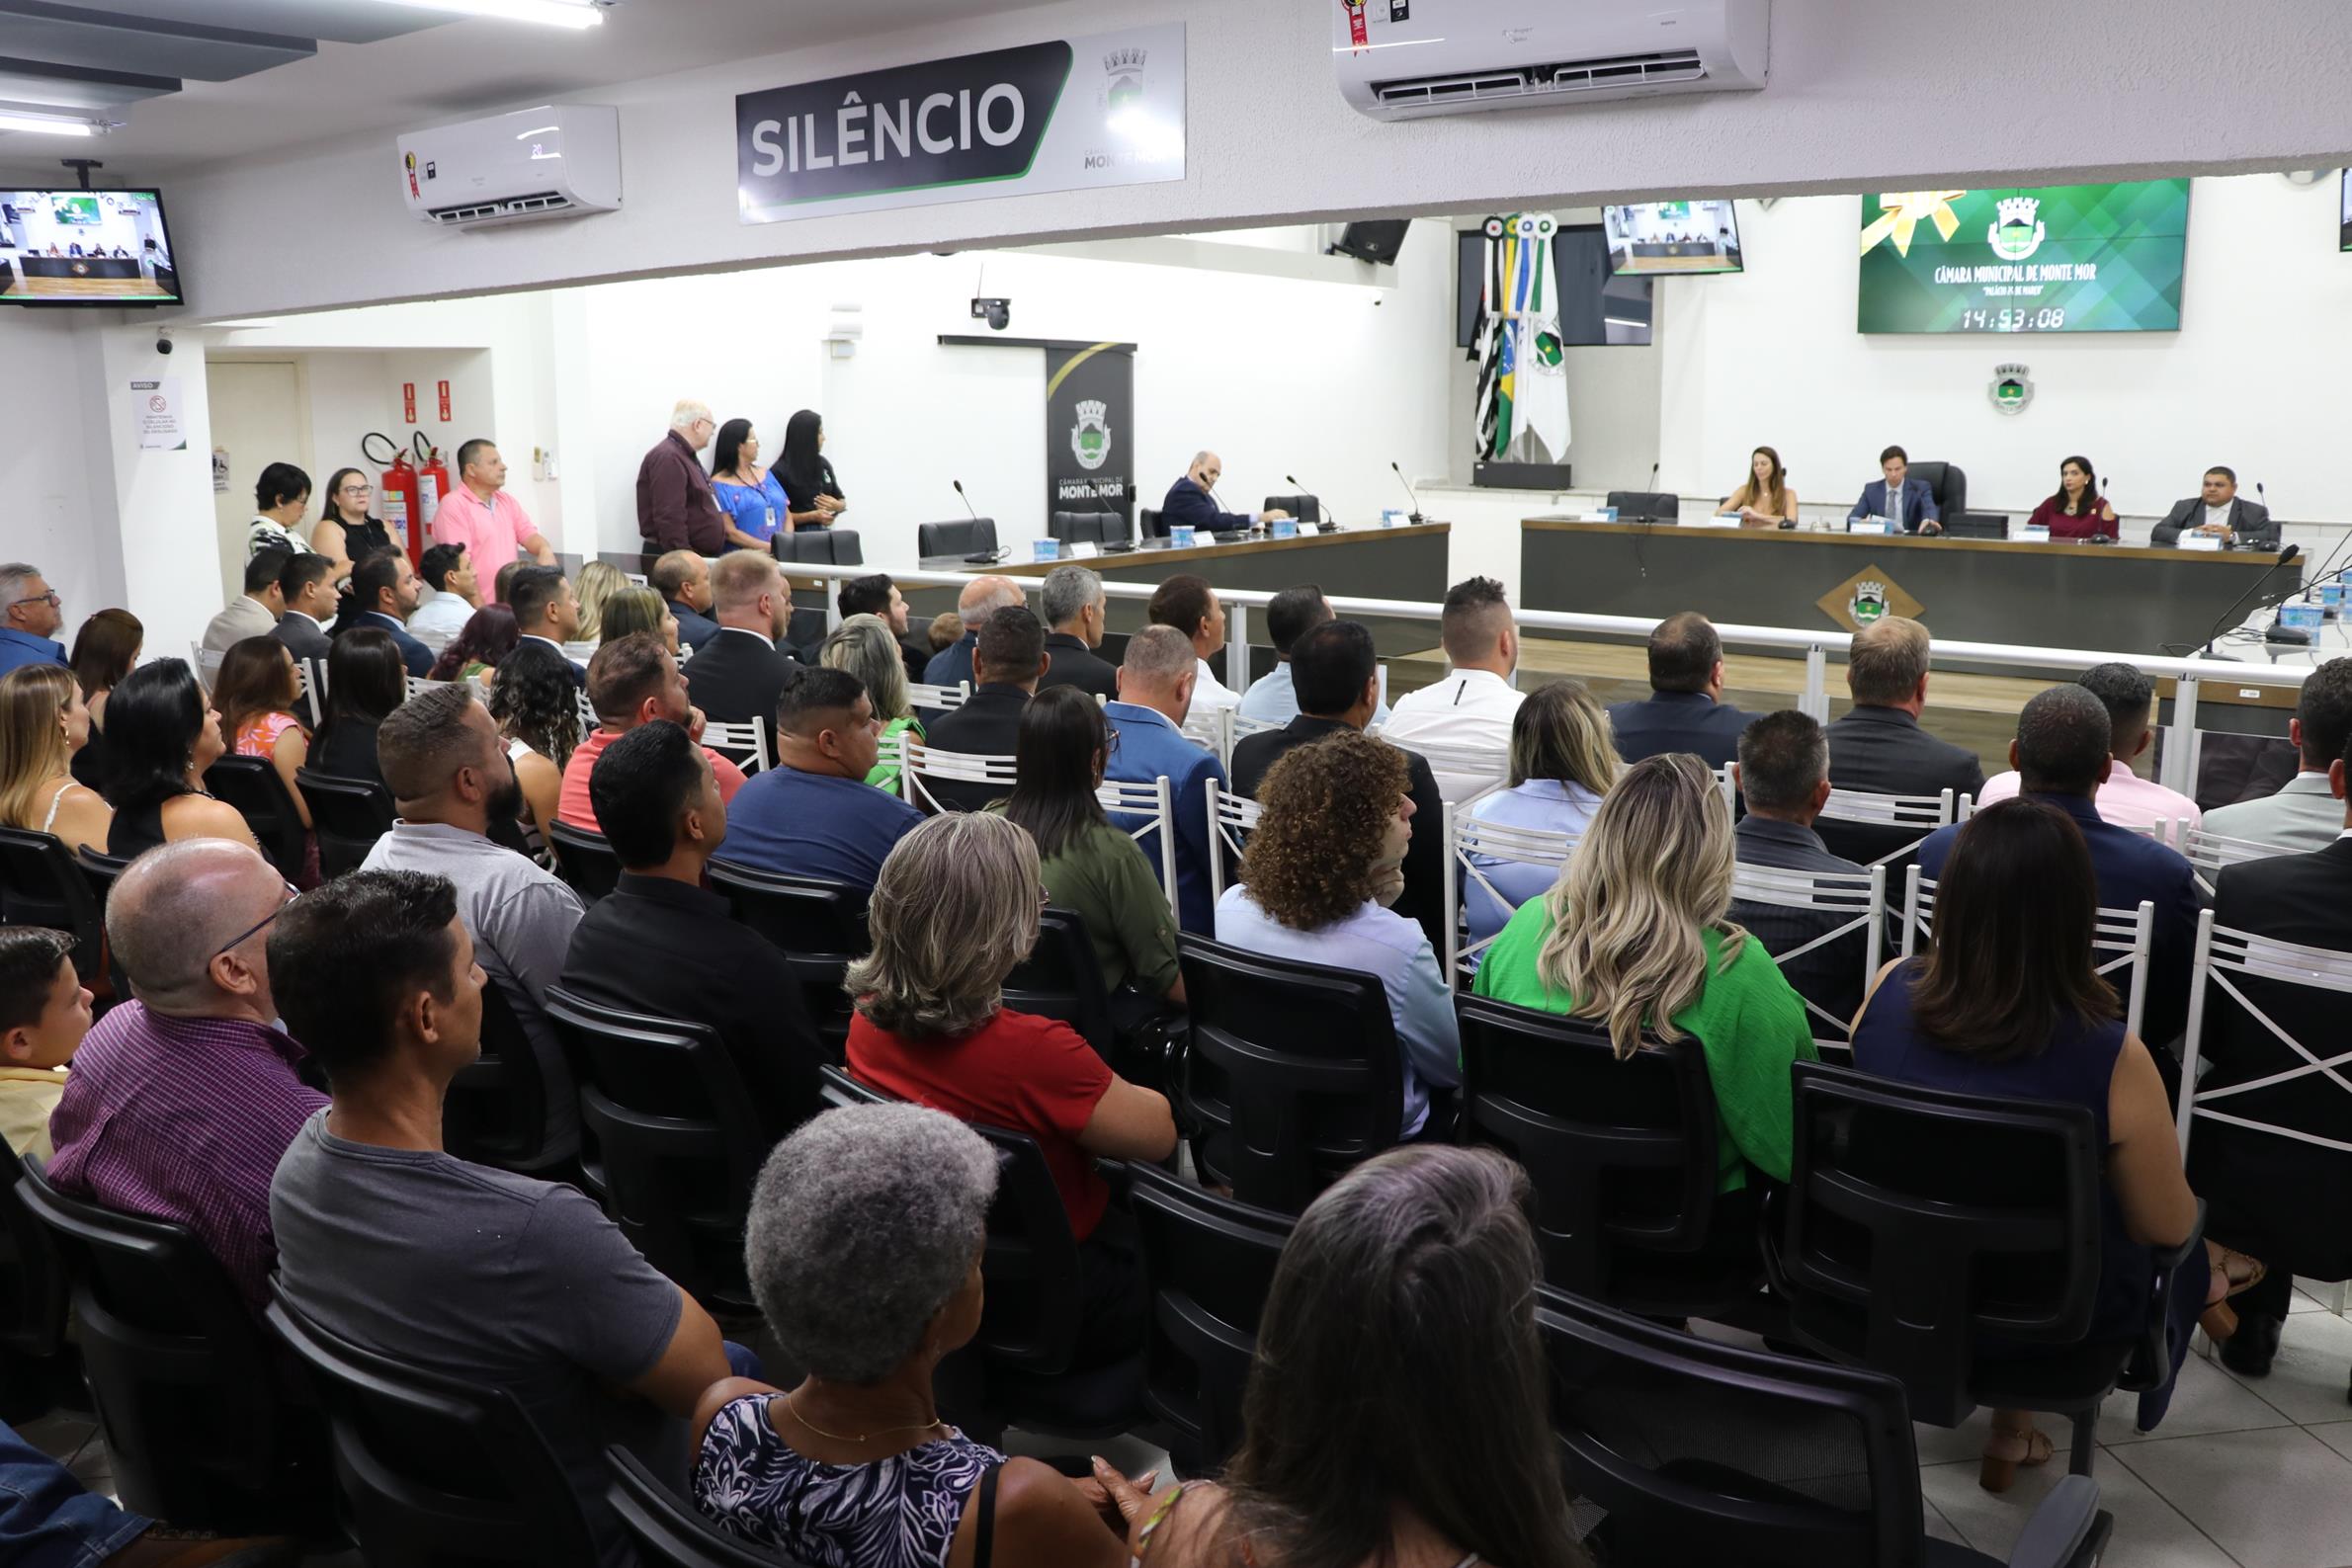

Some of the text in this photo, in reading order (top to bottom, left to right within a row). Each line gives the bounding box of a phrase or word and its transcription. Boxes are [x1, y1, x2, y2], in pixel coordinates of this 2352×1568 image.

[752, 82, 1025, 178] SILÊNCIO
[1935, 263, 2097, 284] CÂMARA MUNICIPAL DE MONTE MOR
[1963, 308, 2064, 329] 14:53:08
[1059, 483, 1124, 500] MONTE MOR
